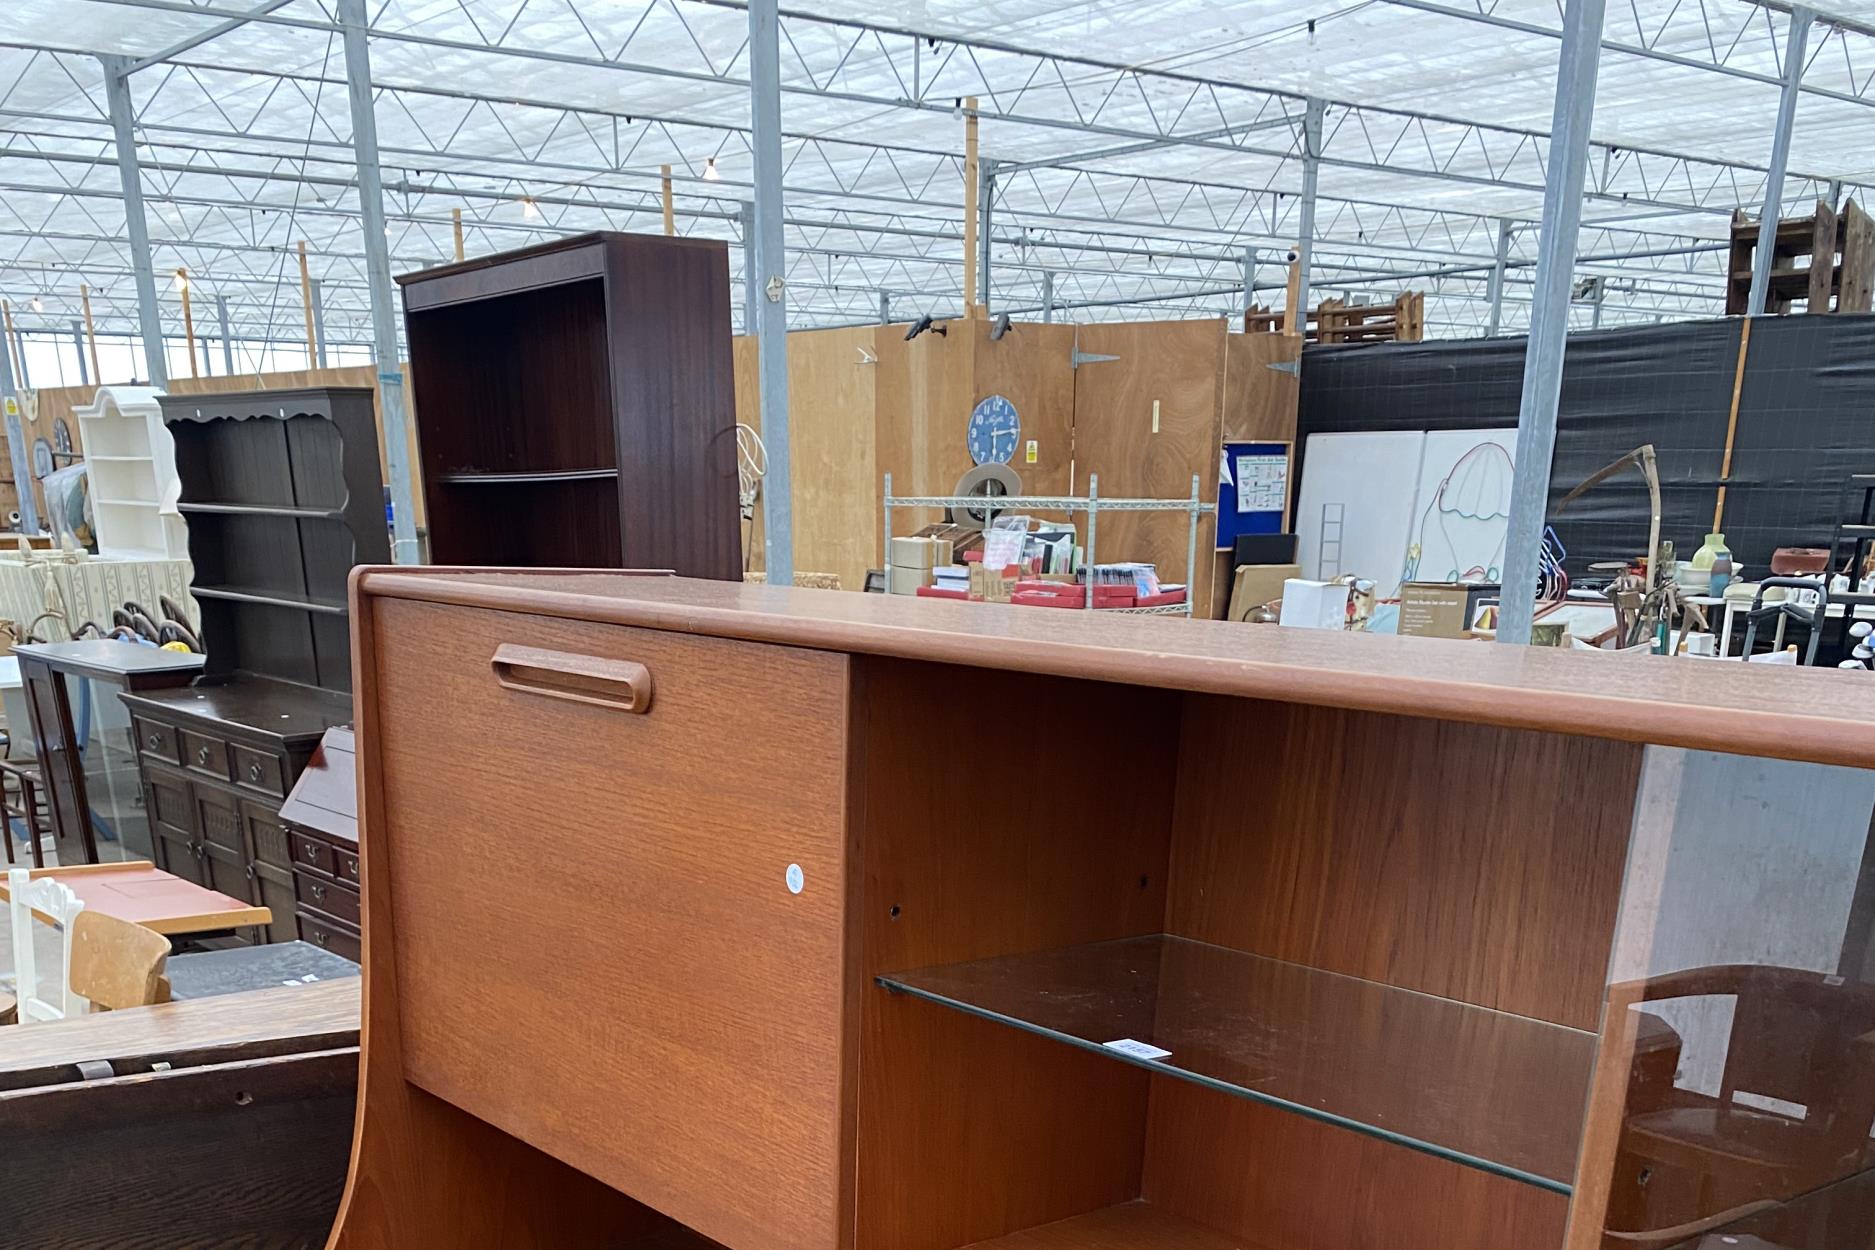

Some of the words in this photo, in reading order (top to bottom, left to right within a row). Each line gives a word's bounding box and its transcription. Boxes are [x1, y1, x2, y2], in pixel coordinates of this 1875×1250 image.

[984, 404, 990, 415] 11
[975, 415, 984, 425] 10
[1009, 415, 1015, 426] 2
[971, 428, 977, 438] 9
